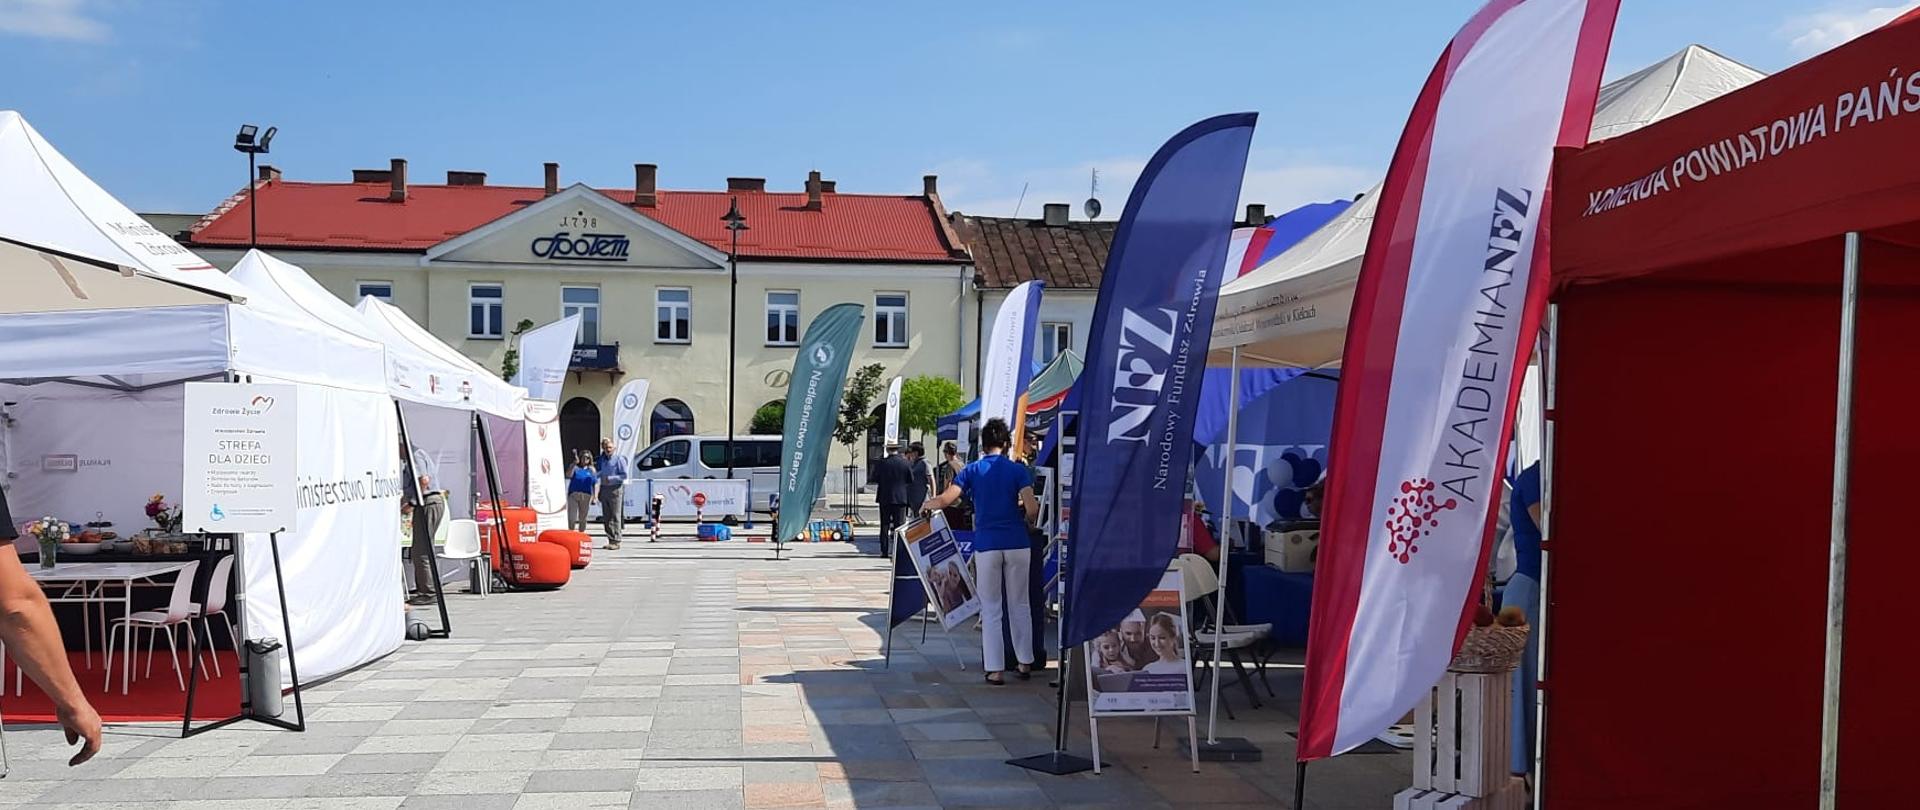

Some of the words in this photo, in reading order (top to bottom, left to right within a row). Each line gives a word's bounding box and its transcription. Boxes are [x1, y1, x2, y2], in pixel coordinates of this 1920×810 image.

[1671, 103, 1827, 188] POWIATOWA
[560, 216, 598, 229] 1798
[1182, 269, 1208, 334] Zdrowia
[1106, 307, 1179, 447] NFZ
[1167, 339, 1191, 404] Fundusz
[795, 370, 822, 449] Nadleśnictwo
[209, 454, 232, 464] DLA
[234, 454, 271, 465] DZIECI
[218, 440, 262, 451] STREFA
[788, 452, 803, 492] Barycz
[1153, 411, 1182, 490] Narodowy
[296, 475, 366, 510] inisterstwo
[366, 470, 401, 499] Zdrowi
